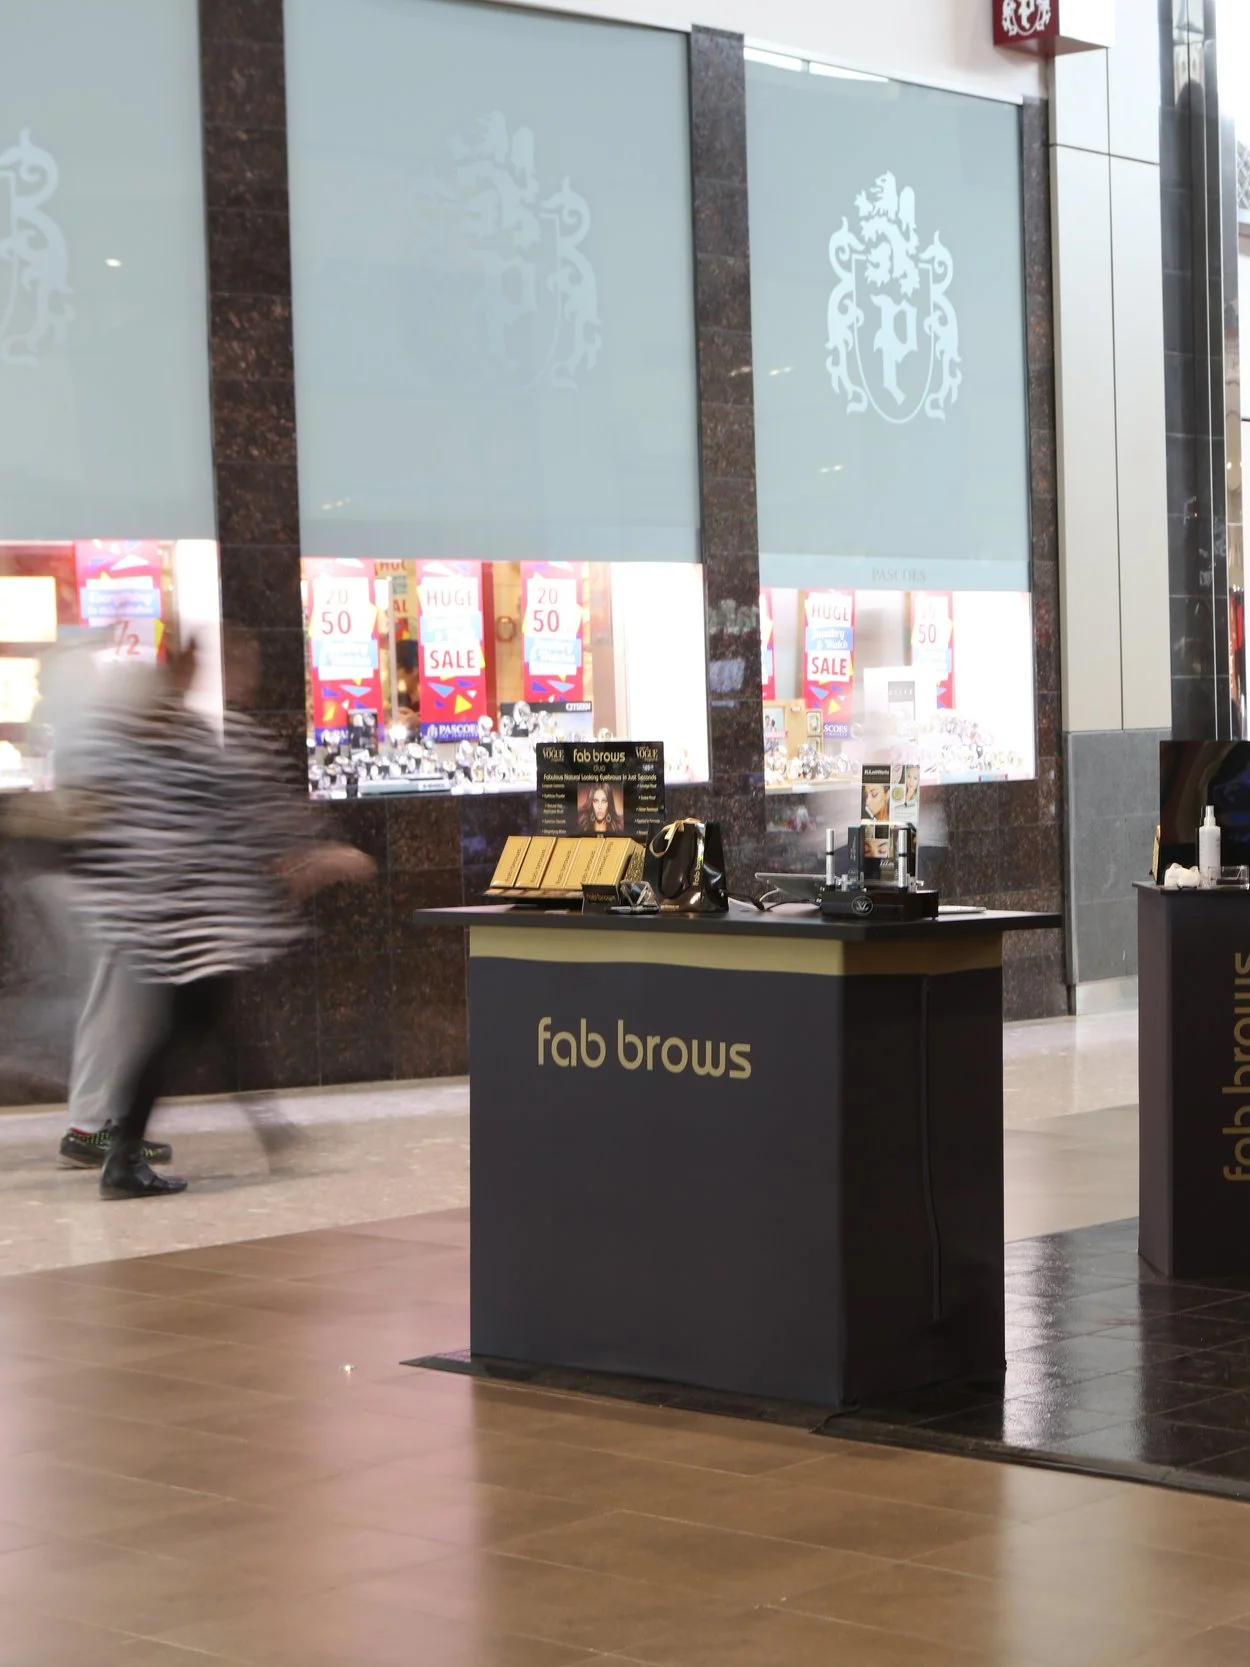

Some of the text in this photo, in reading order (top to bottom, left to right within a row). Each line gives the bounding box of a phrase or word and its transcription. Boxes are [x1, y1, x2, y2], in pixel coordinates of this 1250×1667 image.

[426, 589, 472, 606] HUGE
[533, 610, 559, 632] 50
[812, 604, 848, 621] HUGE
[322, 611, 351, 634] 50
[919, 624, 936, 643] 50
[431, 650, 475, 669] SALE
[812, 657, 847, 676] SALE
[439, 725, 478, 734] PASCOE
[824, 724, 848, 732] SCOES
[573, 749, 625, 762] fab brows
[581, 774, 598, 782] Looking
[538, 1017, 751, 1079] fab brows
